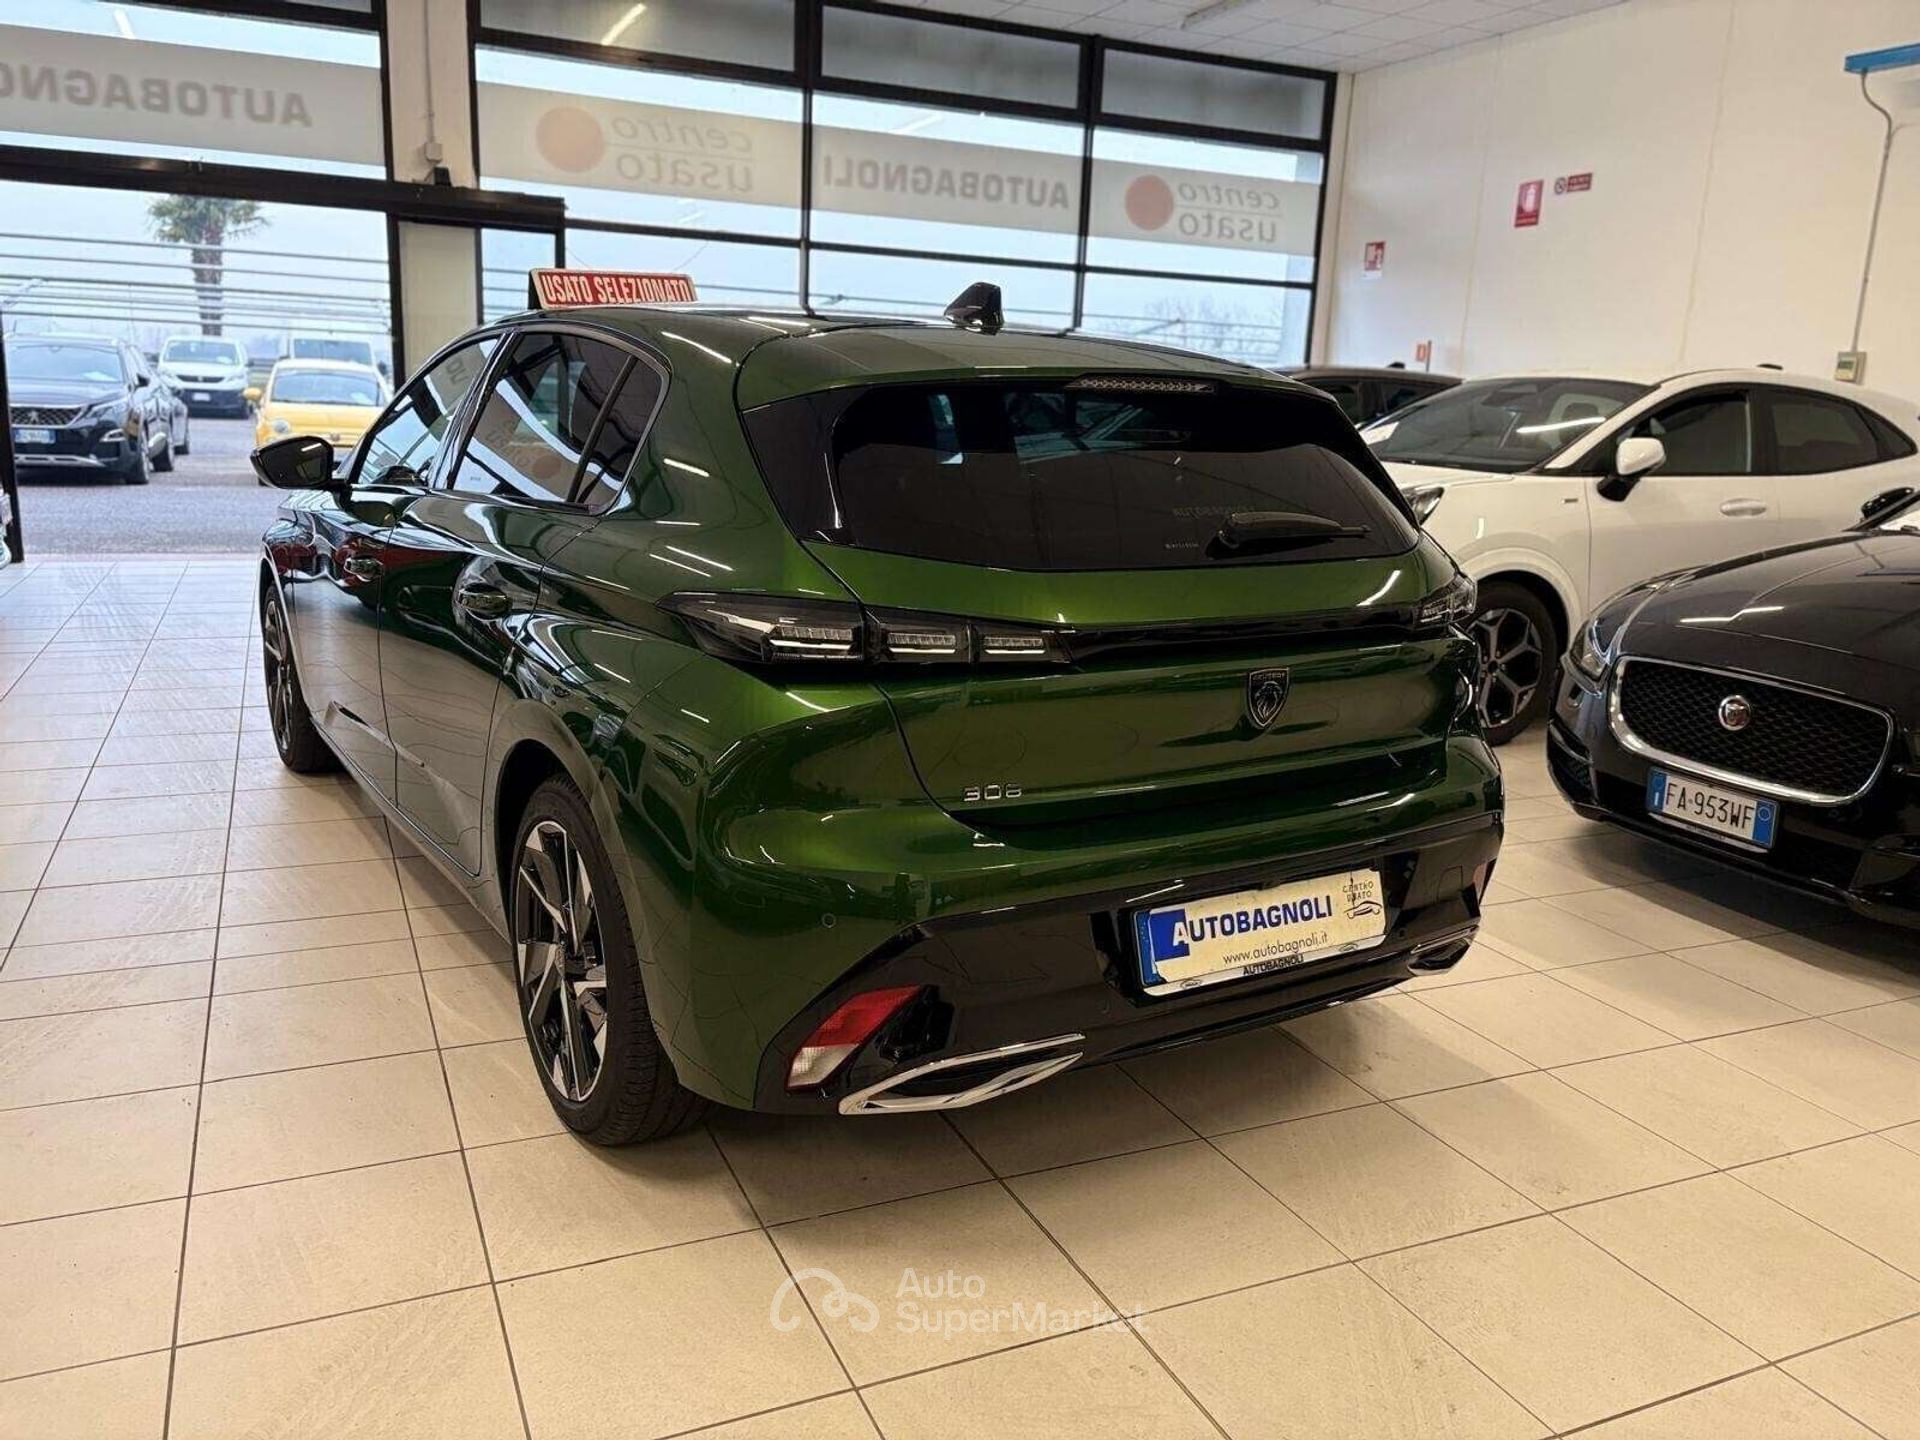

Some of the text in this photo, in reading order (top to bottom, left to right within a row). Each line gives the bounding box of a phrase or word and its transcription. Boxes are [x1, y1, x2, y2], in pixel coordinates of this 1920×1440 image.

[541, 274, 692, 303] USATO SELEZIONATO
[1173, 895, 1333, 946] AUTOBAGNOLI
[1222, 932, 1328, 965] www.autobagnoli.it
